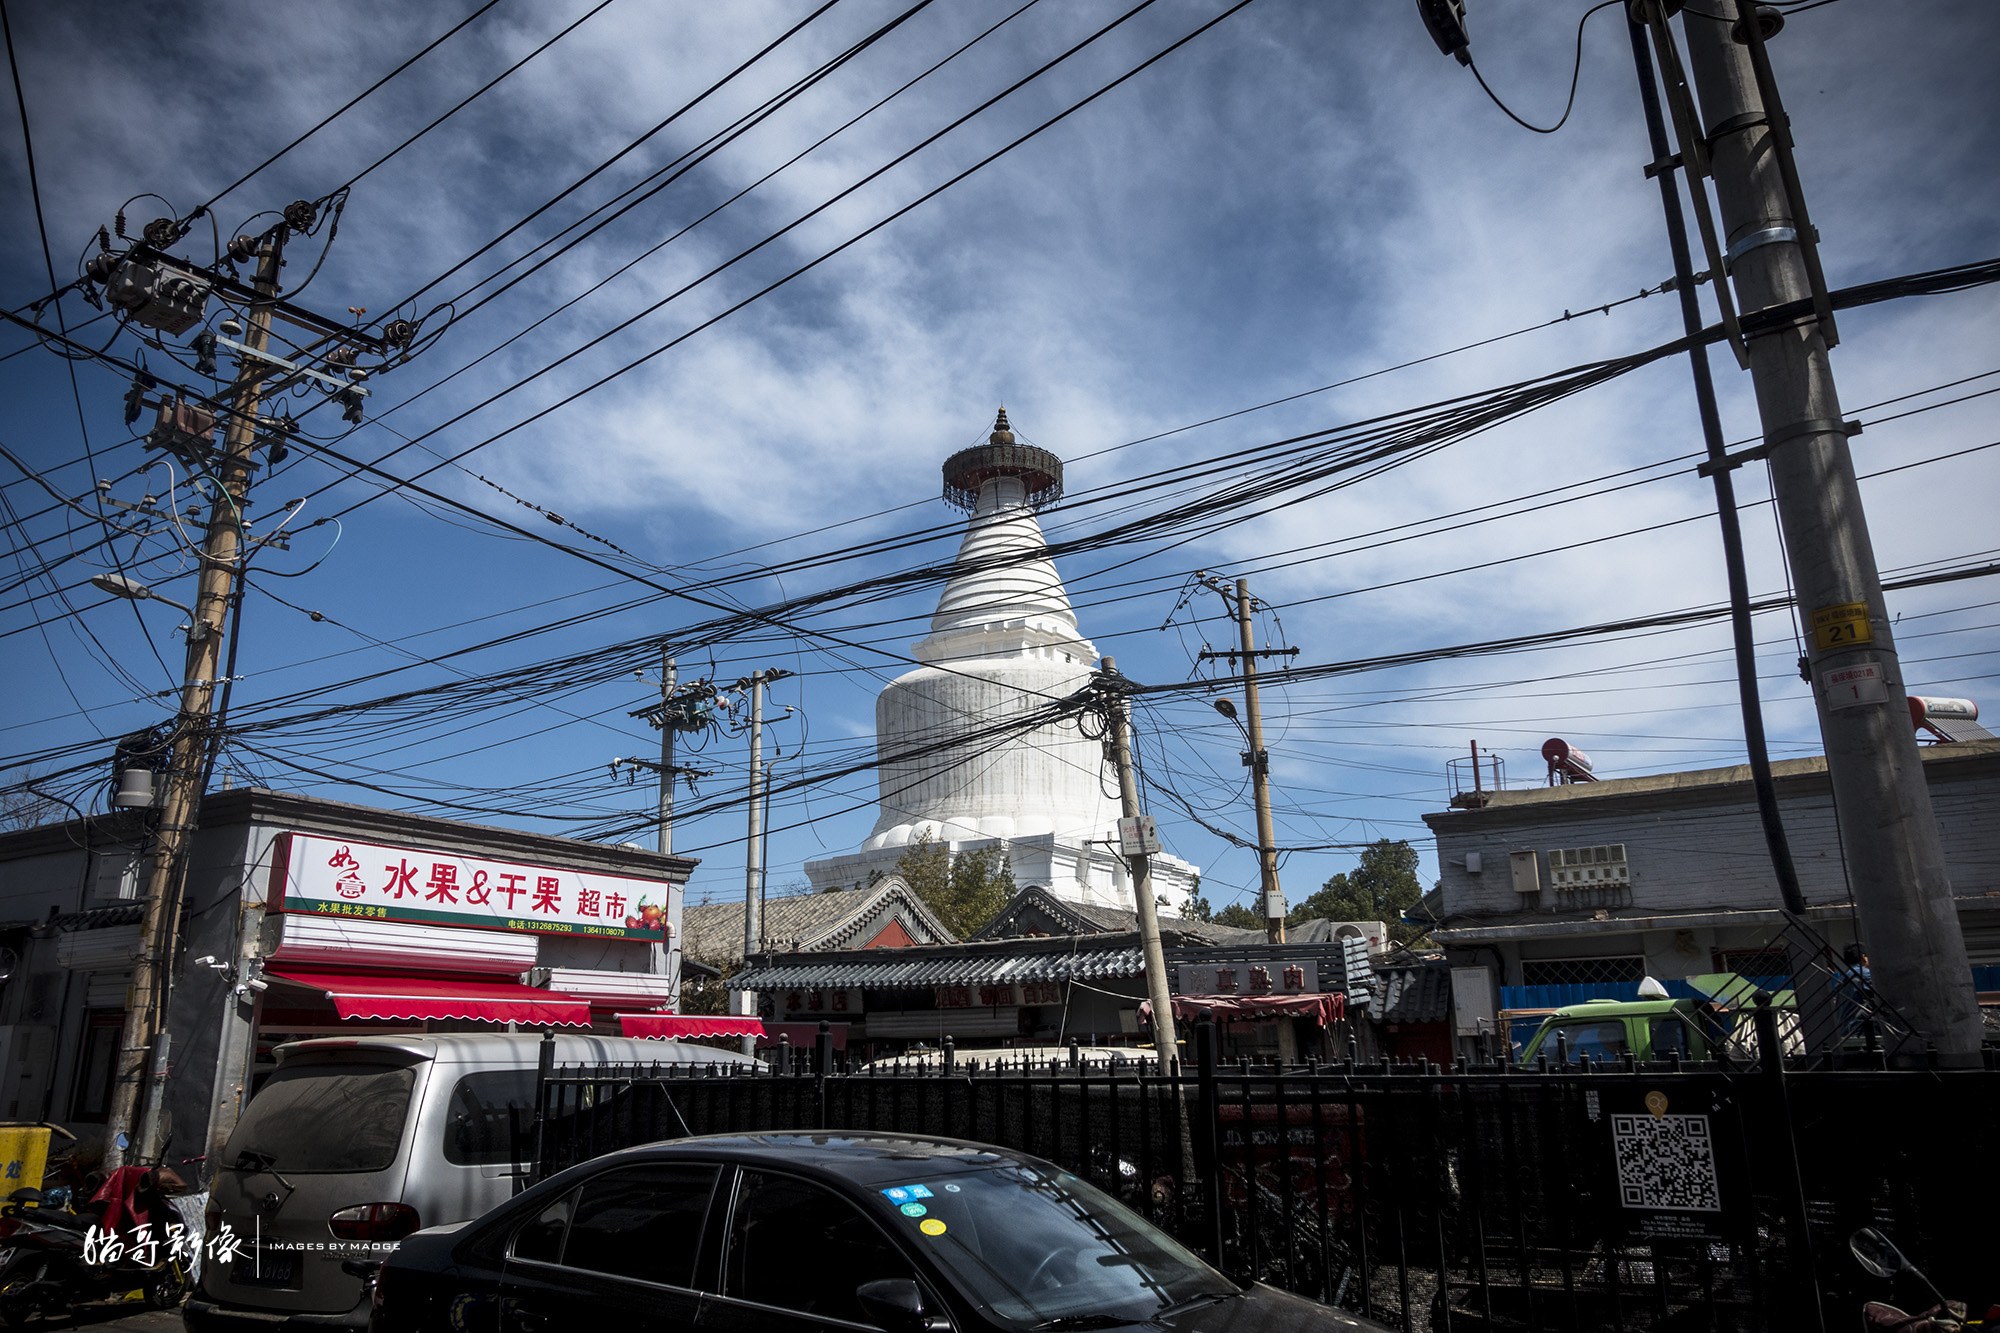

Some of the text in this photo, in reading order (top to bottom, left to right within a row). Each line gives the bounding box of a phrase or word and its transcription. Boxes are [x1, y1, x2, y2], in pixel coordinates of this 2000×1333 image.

[1829, 623, 1856, 642] 21
[1851, 684, 1859, 699] 1
[328, 845, 366, 899] 如意
[317, 901, 388, 918] 水果批发零售
[577, 888, 628, 920] 超市
[583, 926, 625, 937] 13641108079
[1019, 982, 1057, 1004] 百货
